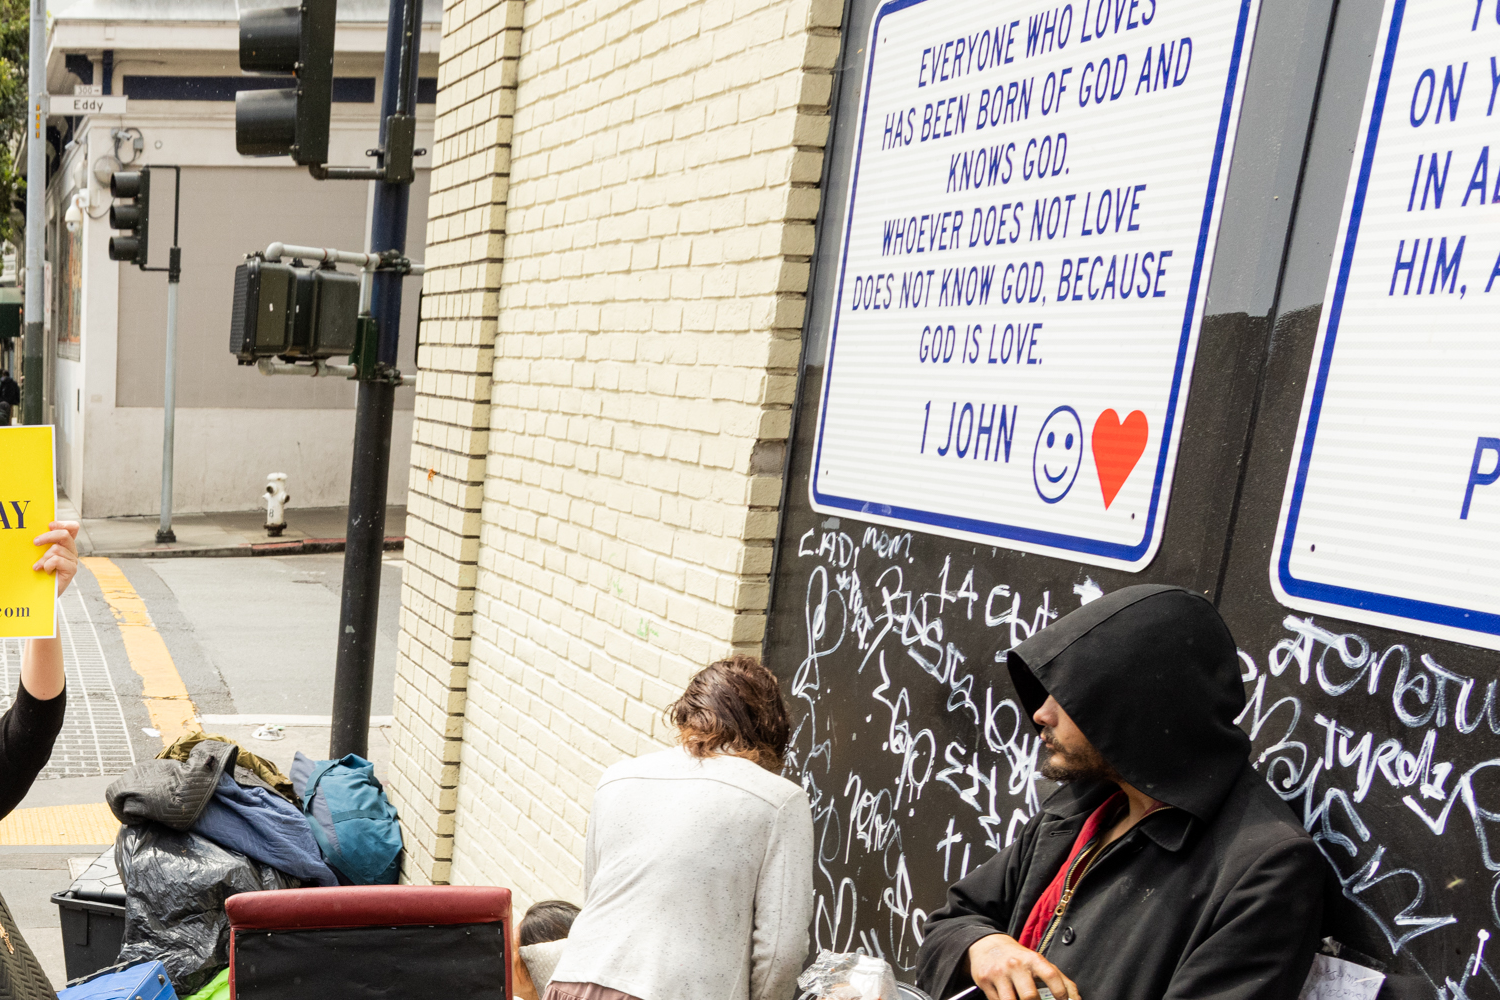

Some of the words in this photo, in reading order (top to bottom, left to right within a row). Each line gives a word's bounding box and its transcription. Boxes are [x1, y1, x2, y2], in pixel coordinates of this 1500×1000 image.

[918, 21, 1019, 88] EVERYONE
[1025, 3, 1073, 61] WHO
[1080, 0, 1157, 44] LOVES
[73, 99, 104, 113] Eddy
[78, 86, 93, 95] 300
[881, 107, 916, 151] HAS
[920, 95, 969, 141] BEEN
[976, 79, 1034, 129] BORN
[1041, 67, 1073, 116] OF
[1079, 52, 1128, 108] GOD
[1134, 36, 1193, 96] AND
[1409, 61, 1469, 129] ON
[946, 143, 1015, 195] KNOWS
[1022, 132, 1070, 181] GOD.
[1406, 151, 1453, 213] IN
[881, 210, 964, 258] WHOEVER
[968, 201, 1023, 248] DOES
[1029, 194, 1075, 244] NOT
[1080, 184, 1148, 236] LOVE
[852, 271, 893, 311] DOES
[899, 267, 936, 310] NOT
[937, 263, 995, 307] KNOW
[1000, 259, 1048, 307] GOD,
[1056, 250, 1174, 303] BECAUSE
[1389, 235, 1468, 301] HIM,
[918, 323, 956, 365] GOD
[962, 323, 981, 364] IS
[987, 322, 1044, 366] LOVE.
[919, 400, 932, 455] 1
[936, 402, 1018, 464] JOHN
